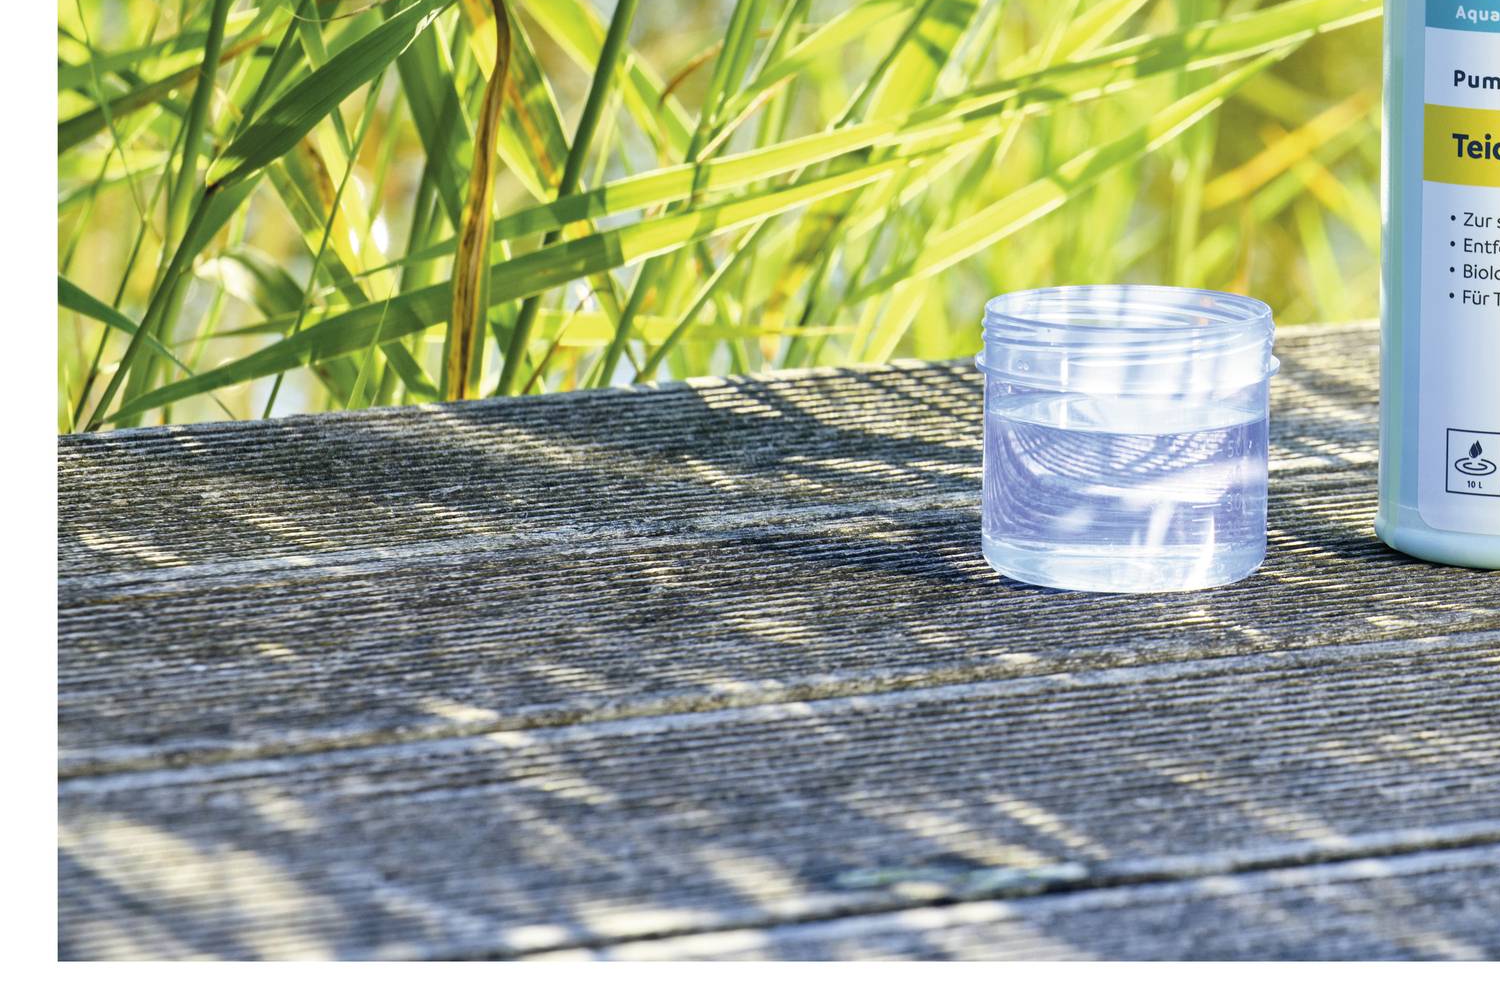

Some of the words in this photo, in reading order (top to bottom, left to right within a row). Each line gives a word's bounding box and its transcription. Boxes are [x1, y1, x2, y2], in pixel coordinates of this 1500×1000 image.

[1463, 211, 1493, 228] Zur
[1462, 289, 1490, 306] Für
[1467, 480, 1476, 489] 10
